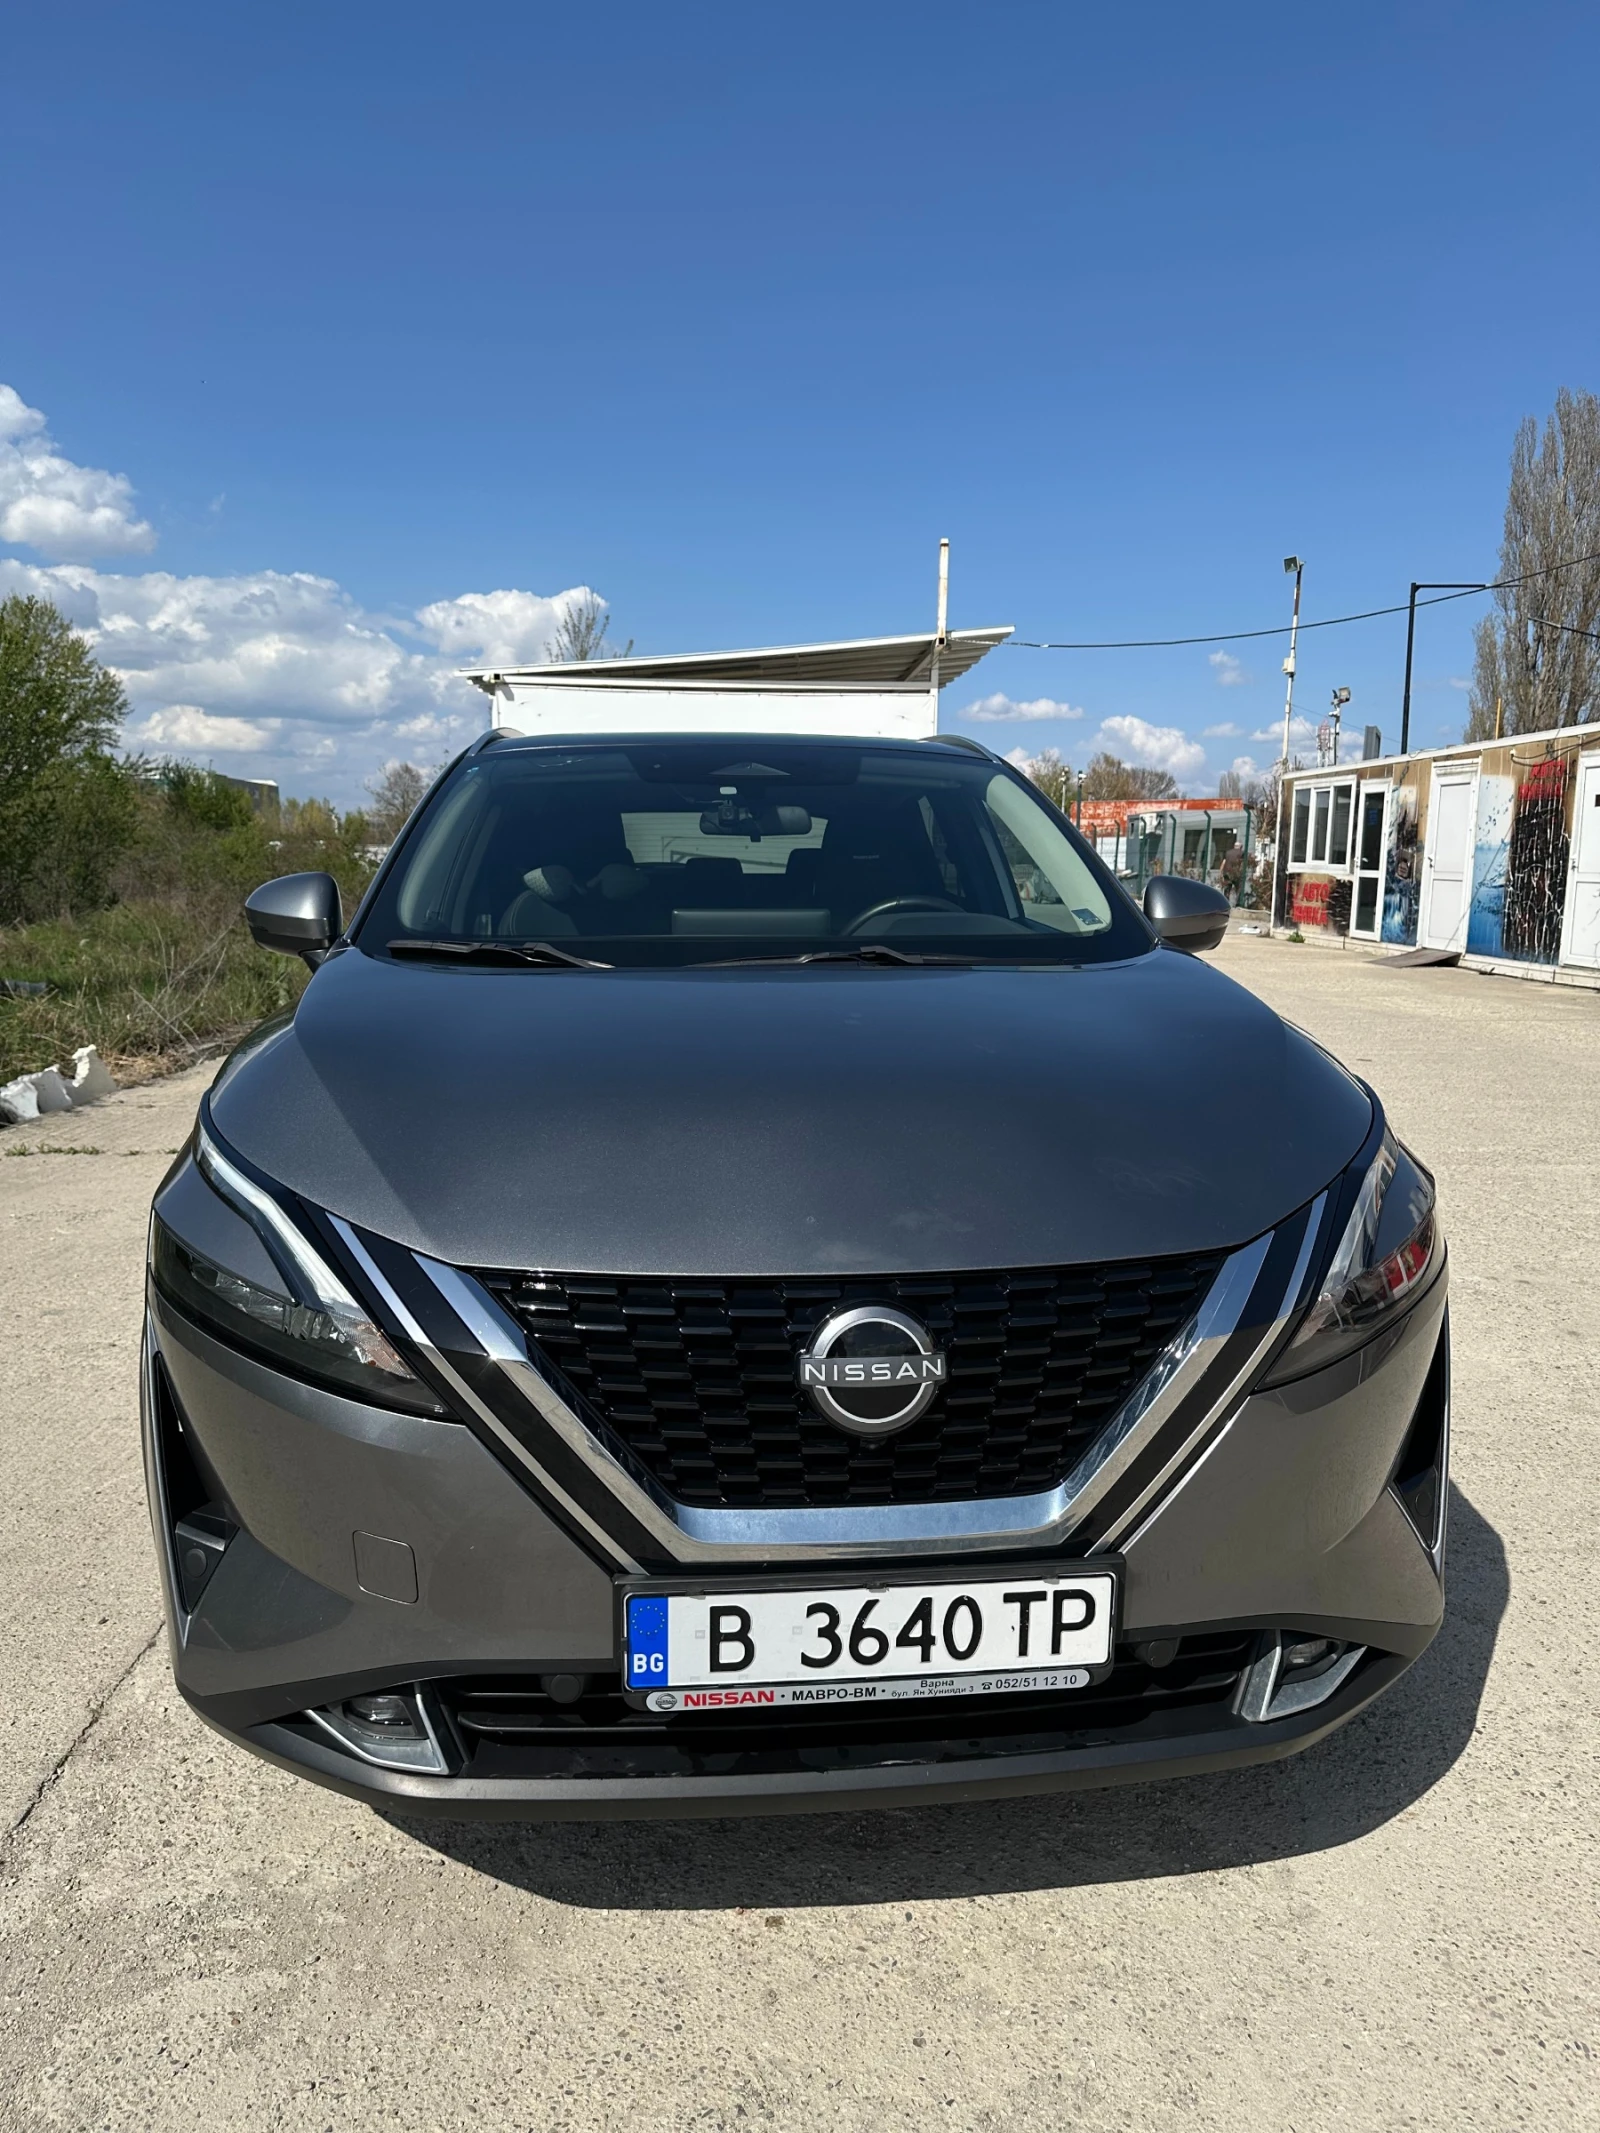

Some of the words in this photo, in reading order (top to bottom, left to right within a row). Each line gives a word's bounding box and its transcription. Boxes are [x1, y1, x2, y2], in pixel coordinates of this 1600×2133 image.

[804, 1358, 942, 1381] NISSAN
[800, 1594, 983, 1669] 3640
[633, 1653, 664, 1673] BG
[920, 1679, 955, 1689] Варна
[995, 1677, 1038, 1690] 052/51
[1043, 1676, 1058, 1686] 12
[1063, 1674, 1078, 1685] 10
[683, 1690, 775, 1707] NISSAN
[891, 1688, 911, 1698] бул.
[912, 1688, 926, 1696] Ян
[970, 1685, 975, 1693] 3
